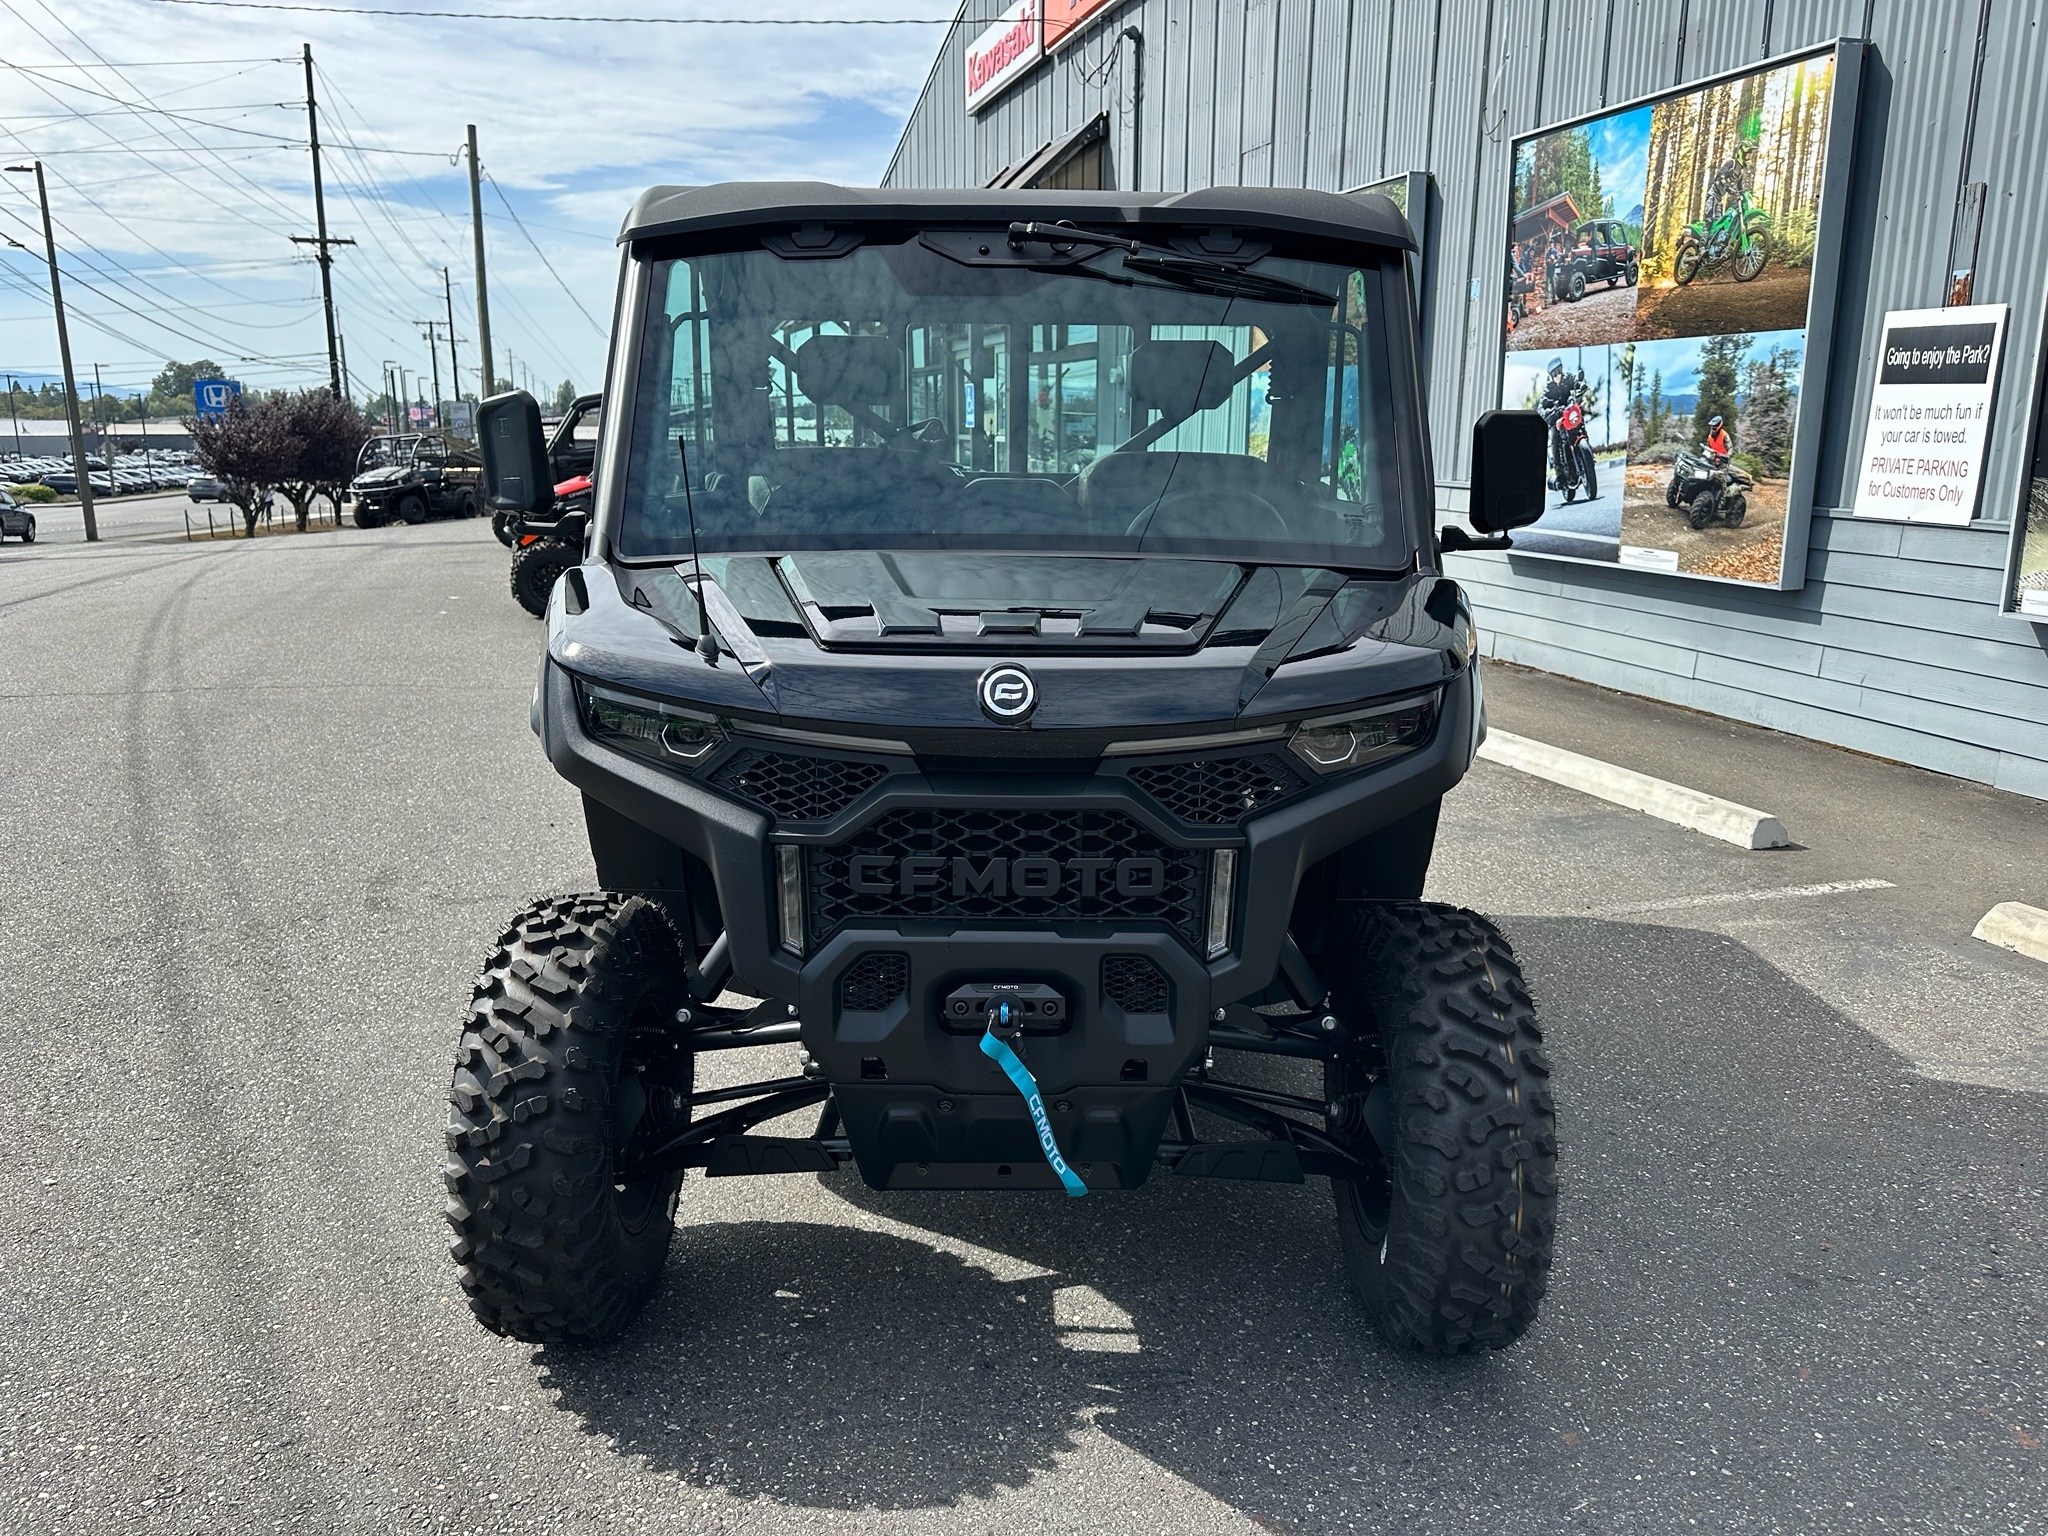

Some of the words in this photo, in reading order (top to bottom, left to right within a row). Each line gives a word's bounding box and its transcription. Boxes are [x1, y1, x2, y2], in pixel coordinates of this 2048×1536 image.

[968, 0, 1035, 97] Kawasaki
[1887, 347, 1911, 369] Going
[1912, 347, 1920, 365] to
[1921, 346, 1945, 369] enjoy
[1945, 345, 1961, 365] the
[1962, 344, 1990, 364] Park?
[1874, 405, 1882, 420] It
[1883, 404, 1908, 420] won't
[1909, 404, 1922, 420] be
[1924, 403, 1953, 420] much
[1955, 403, 1972, 420] fun
[1975, 403, 1984, 419] if
[1881, 430, 1903, 446] your
[1904, 430, 1921, 443] car
[1921, 427, 1931, 443] is
[1933, 427, 1967, 444] towed.
[1871, 457, 1915, 475] PRIVATE
[1916, 459, 1969, 478] PARKING
[1868, 480, 1881, 497] for
[1882, 481, 1936, 501] Customers
[1938, 484, 1964, 507] Only
[849, 854, 1166, 898] CFMOTO
[1029, 1093, 1066, 1175] CFMOTO
